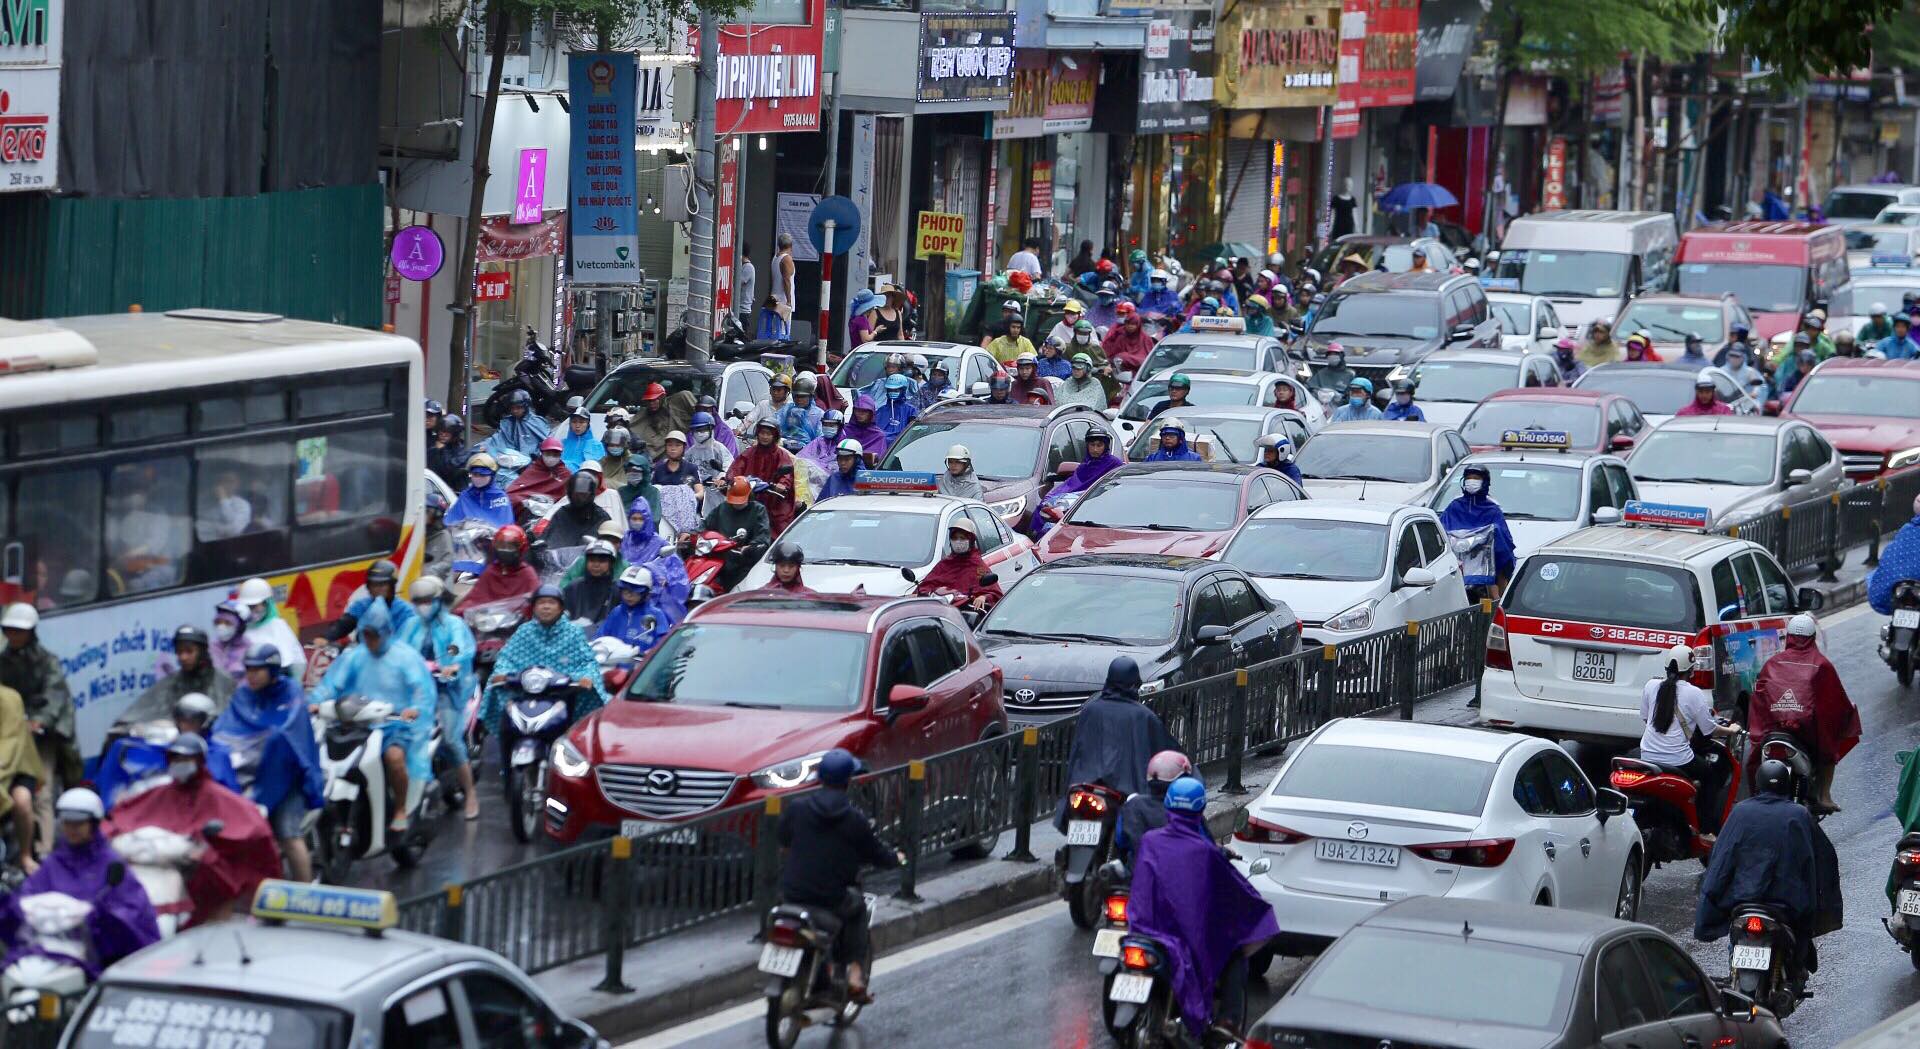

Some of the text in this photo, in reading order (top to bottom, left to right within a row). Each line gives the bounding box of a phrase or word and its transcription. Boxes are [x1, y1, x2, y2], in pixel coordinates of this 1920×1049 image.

[920, 213, 963, 233] PHOTO
[922, 234, 958, 253] COPY
[576, 259, 636, 269] Vietcombank
[1549, 435, 1566, 443] SAO
[866, 476, 928, 484] TAXIGROUP
[1635, 508, 1705, 519] TAXIGROUP
[1541, 622, 1564, 633] CP
[1607, 628, 1686, 646] 38.26.26.26
[1584, 653, 1605, 667] 30A
[1575, 666, 1613, 681] 820.50
[1320, 840, 1395, 865] 19A-213.24
[1735, 957, 1767, 968] 283.72
